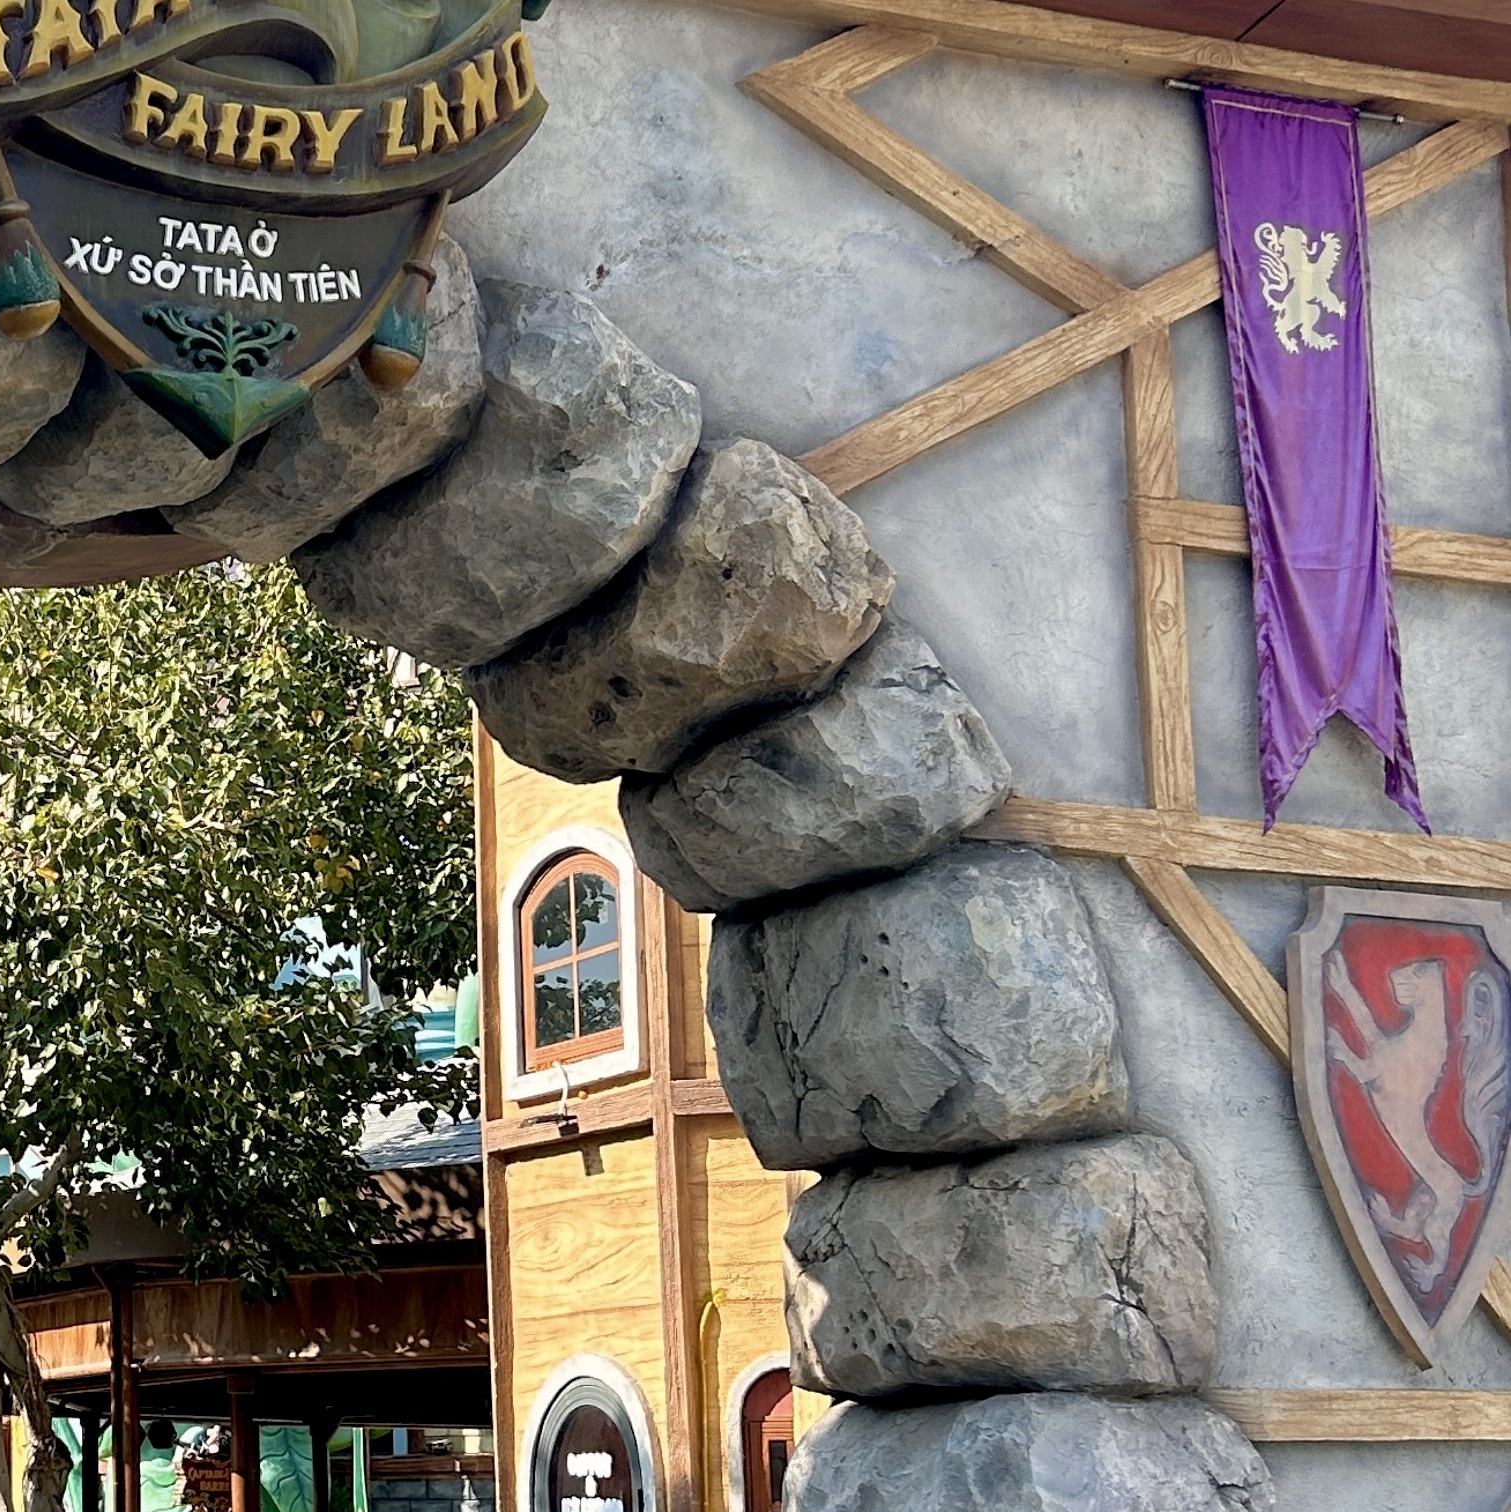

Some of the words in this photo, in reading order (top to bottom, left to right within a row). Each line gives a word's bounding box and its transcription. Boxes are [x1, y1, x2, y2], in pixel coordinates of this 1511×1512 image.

[123, 71, 364, 173] FAIRY
[377, 31, 536, 168] LAND
[63, 236, 125, 276] XỨ
[127, 252, 186, 292] SỞ
[288, 263, 362, 303] TIÊN
[158, 216, 245, 257] TATA
[248, 219, 279, 259] Ở
